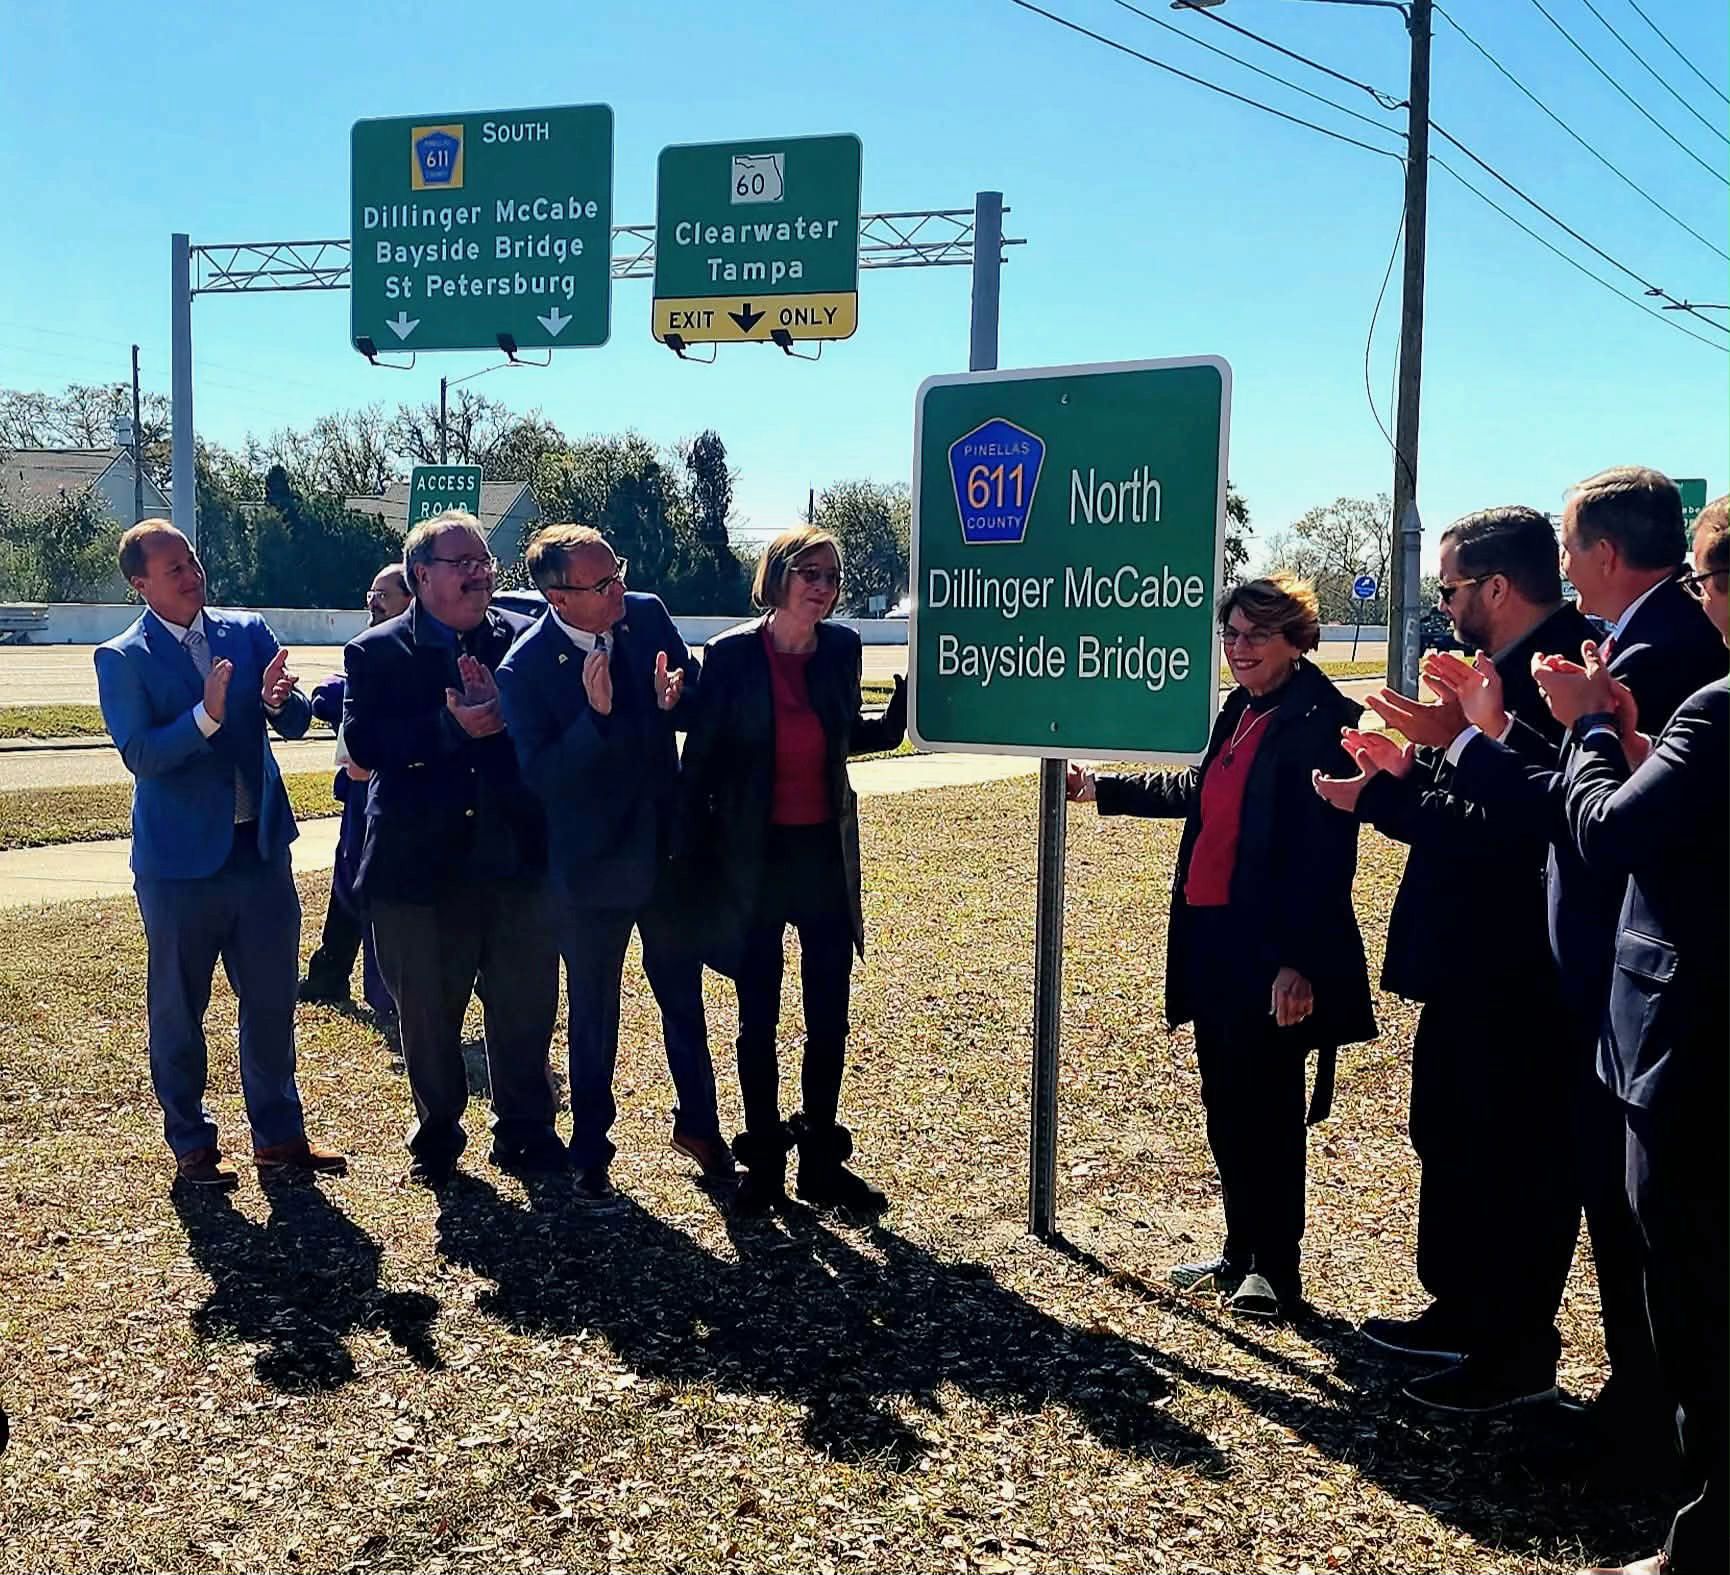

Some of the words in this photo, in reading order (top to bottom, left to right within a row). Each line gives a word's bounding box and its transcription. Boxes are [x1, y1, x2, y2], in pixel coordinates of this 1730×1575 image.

[482, 121, 550, 144] SOUTH
[426, 149, 449, 168] 611
[736, 173, 765, 196] 60
[363, 203, 481, 232] Dillinger
[496, 196, 598, 224] McCabe
[675, 216, 839, 245] Clearwater
[376, 238, 480, 268] Bayside
[495, 233, 584, 264] Bridge
[707, 258, 804, 285] Tampa
[385, 275, 412, 298] St
[427, 272, 576, 300] Petersburg
[669, 311, 715, 329] EXIT
[779, 306, 838, 325] ONLY
[964, 441, 1031, 456] PINELLAS
[416, 475, 475, 491] ACCESS
[967, 463, 1024, 509] 611
[1070, 464, 1161, 525] North
[967, 515, 1024, 529] COUNTY
[928, 567, 1055, 619] Dillinger
[1064, 565, 1205, 608] McCabe
[938, 634, 1066, 687] Bayside
[1078, 635, 1191, 691] Bridge
